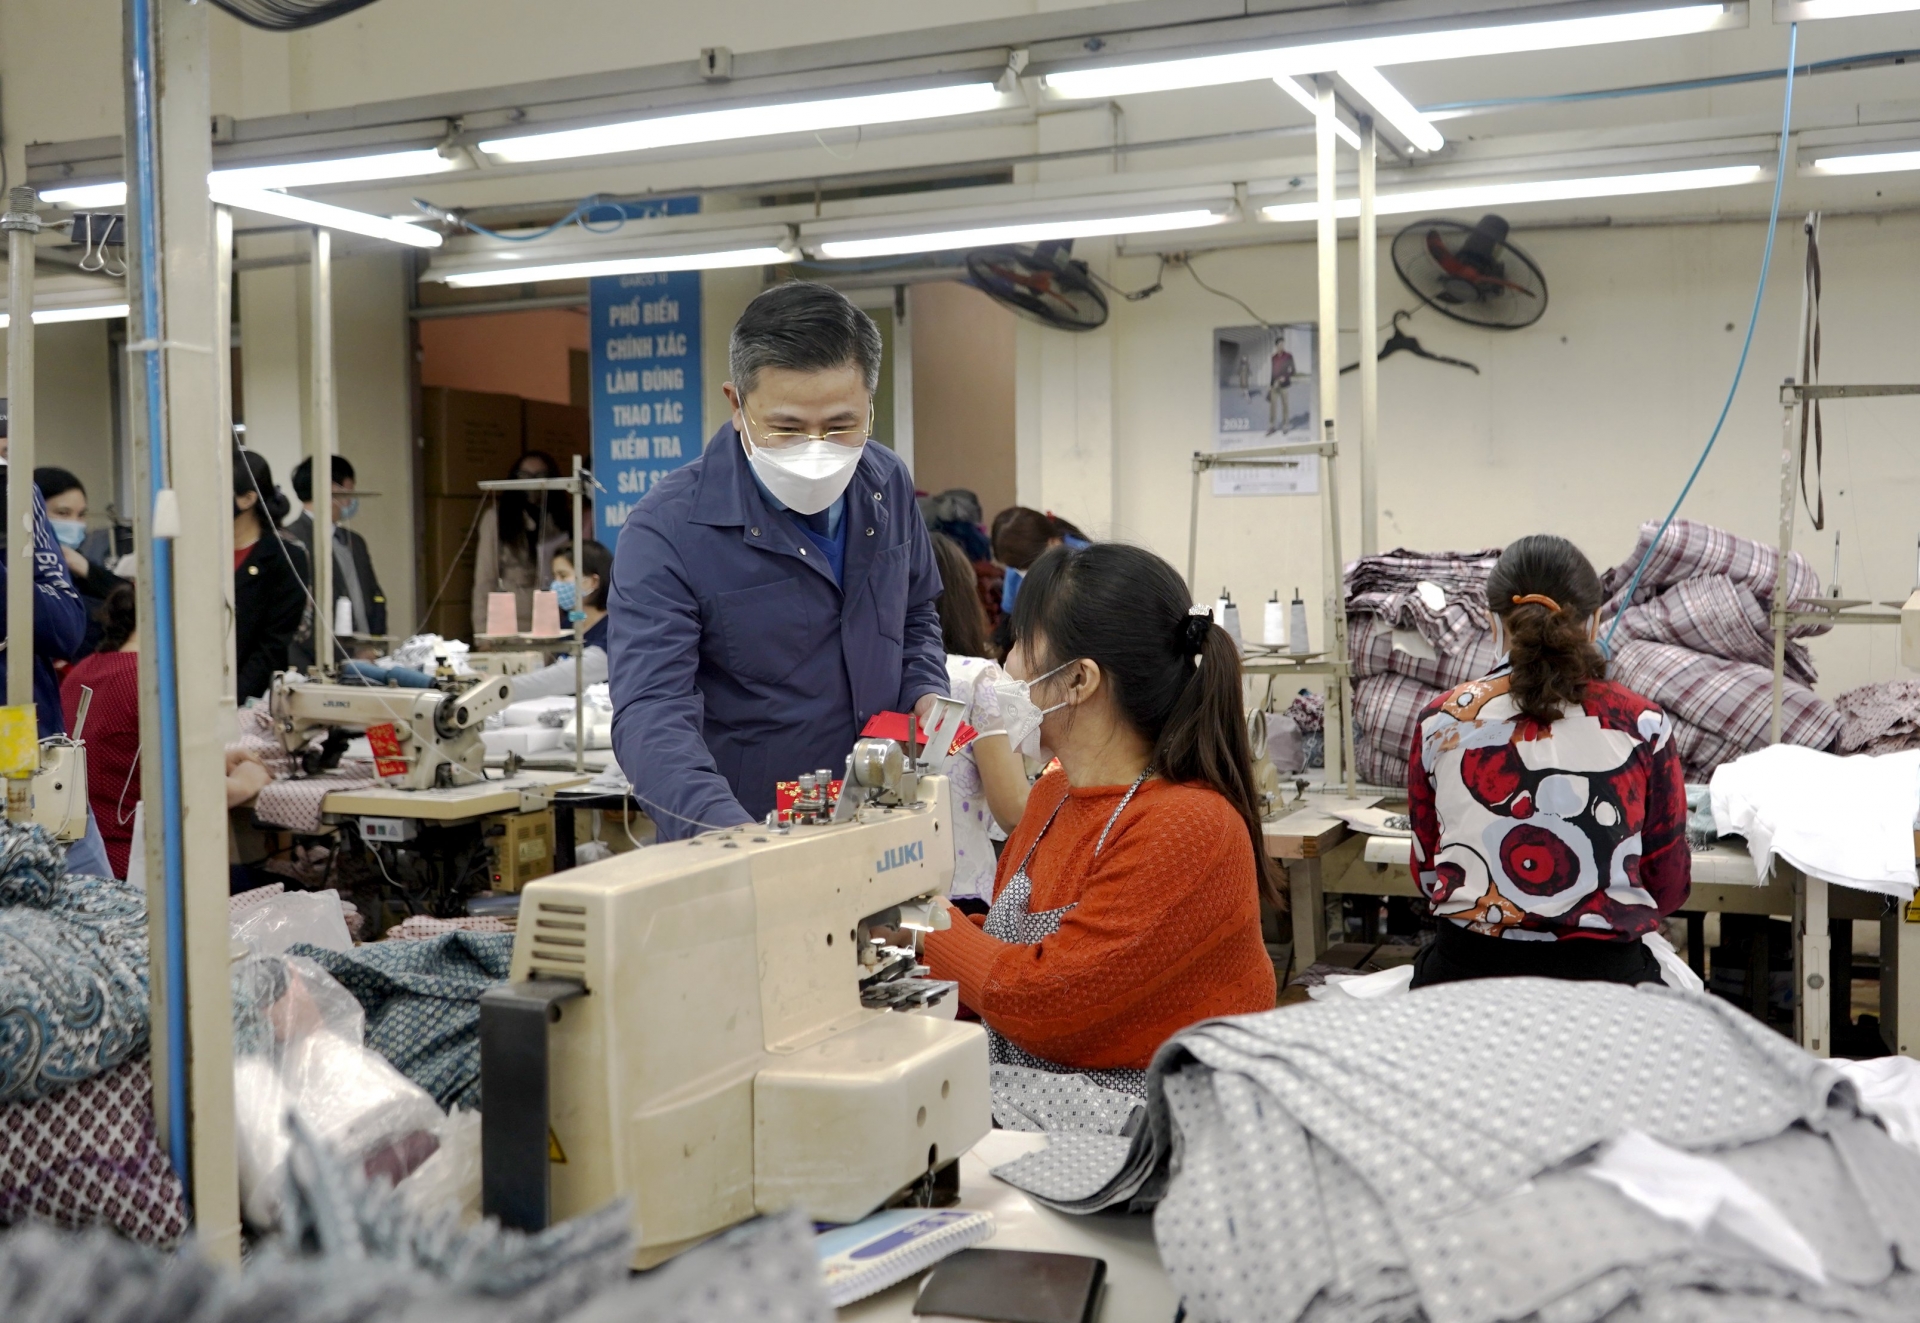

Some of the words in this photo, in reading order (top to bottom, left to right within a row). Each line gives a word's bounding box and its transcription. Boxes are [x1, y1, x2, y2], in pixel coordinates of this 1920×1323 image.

[609, 295, 640, 327] PHỔ
[643, 294, 679, 325] BIẾN
[606, 333, 653, 361] CHÍNH
[656, 330, 687, 358] XÁC
[606, 367, 639, 394] LÀM
[642, 365, 684, 392] ĐÚNG
[613, 403, 651, 427] THAO
[654, 398, 683, 424] TÁC
[611, 429, 649, 460] KIỂM
[652, 436, 682, 458] TRA
[617, 466, 646, 494] SÁT
[877, 840, 924, 873] JUKI
